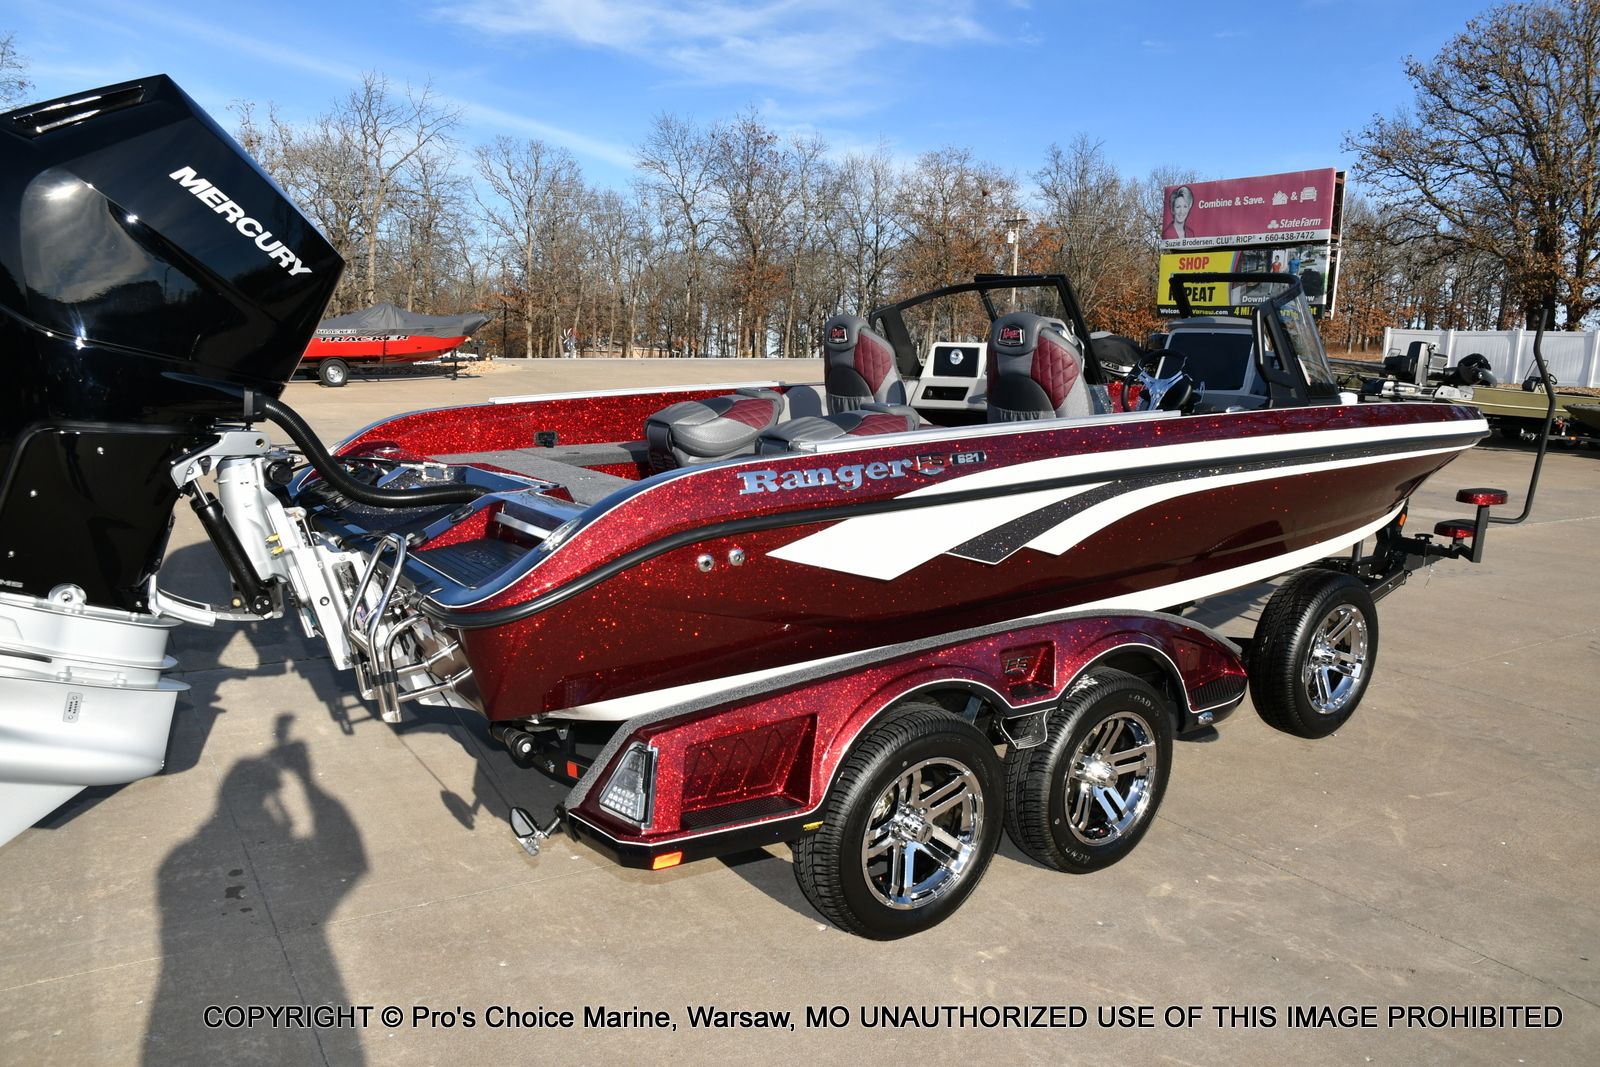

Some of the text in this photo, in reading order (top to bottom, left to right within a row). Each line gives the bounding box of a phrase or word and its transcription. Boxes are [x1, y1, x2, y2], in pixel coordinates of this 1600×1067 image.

[1198, 195, 1265, 209] Combine & Save.
[1290, 191, 1298, 201] &
[168, 166, 313, 277] MERCURY
[1165, 240, 1181, 248] Suzie
[1264, 231, 1315, 241] 660-438-7472
[1178, 256, 1210, 271] SHOP
[1233, 306, 1240, 316] 4
[320, 335, 409, 343] TRACKER
[736, 457, 913, 496] Ranger
[957, 452, 980, 464] 621
